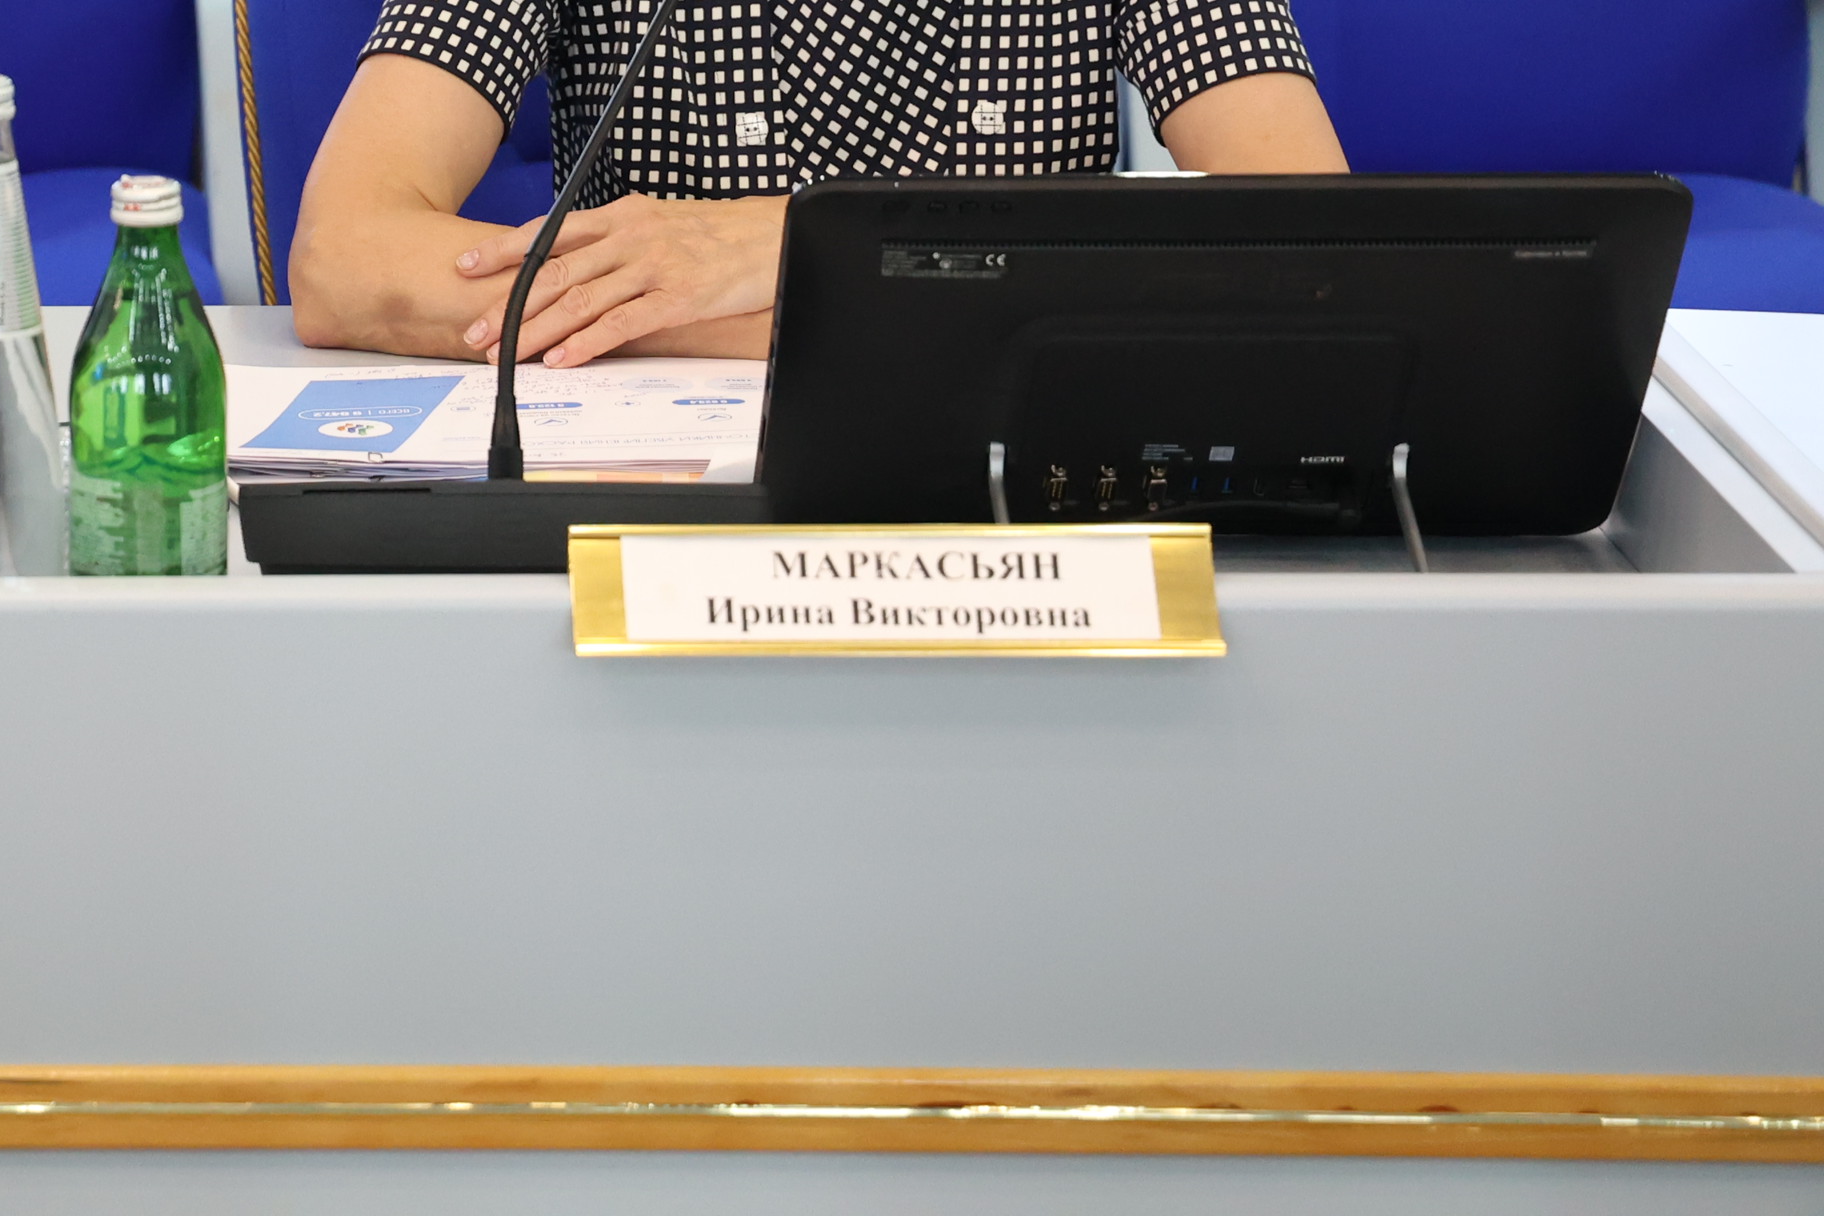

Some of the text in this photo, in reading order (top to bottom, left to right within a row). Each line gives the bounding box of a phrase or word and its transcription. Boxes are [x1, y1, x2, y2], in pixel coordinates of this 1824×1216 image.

[771, 550, 1063, 582] МАРКАСЬЯН
[704, 598, 1093, 635] Ирина Викторовна
